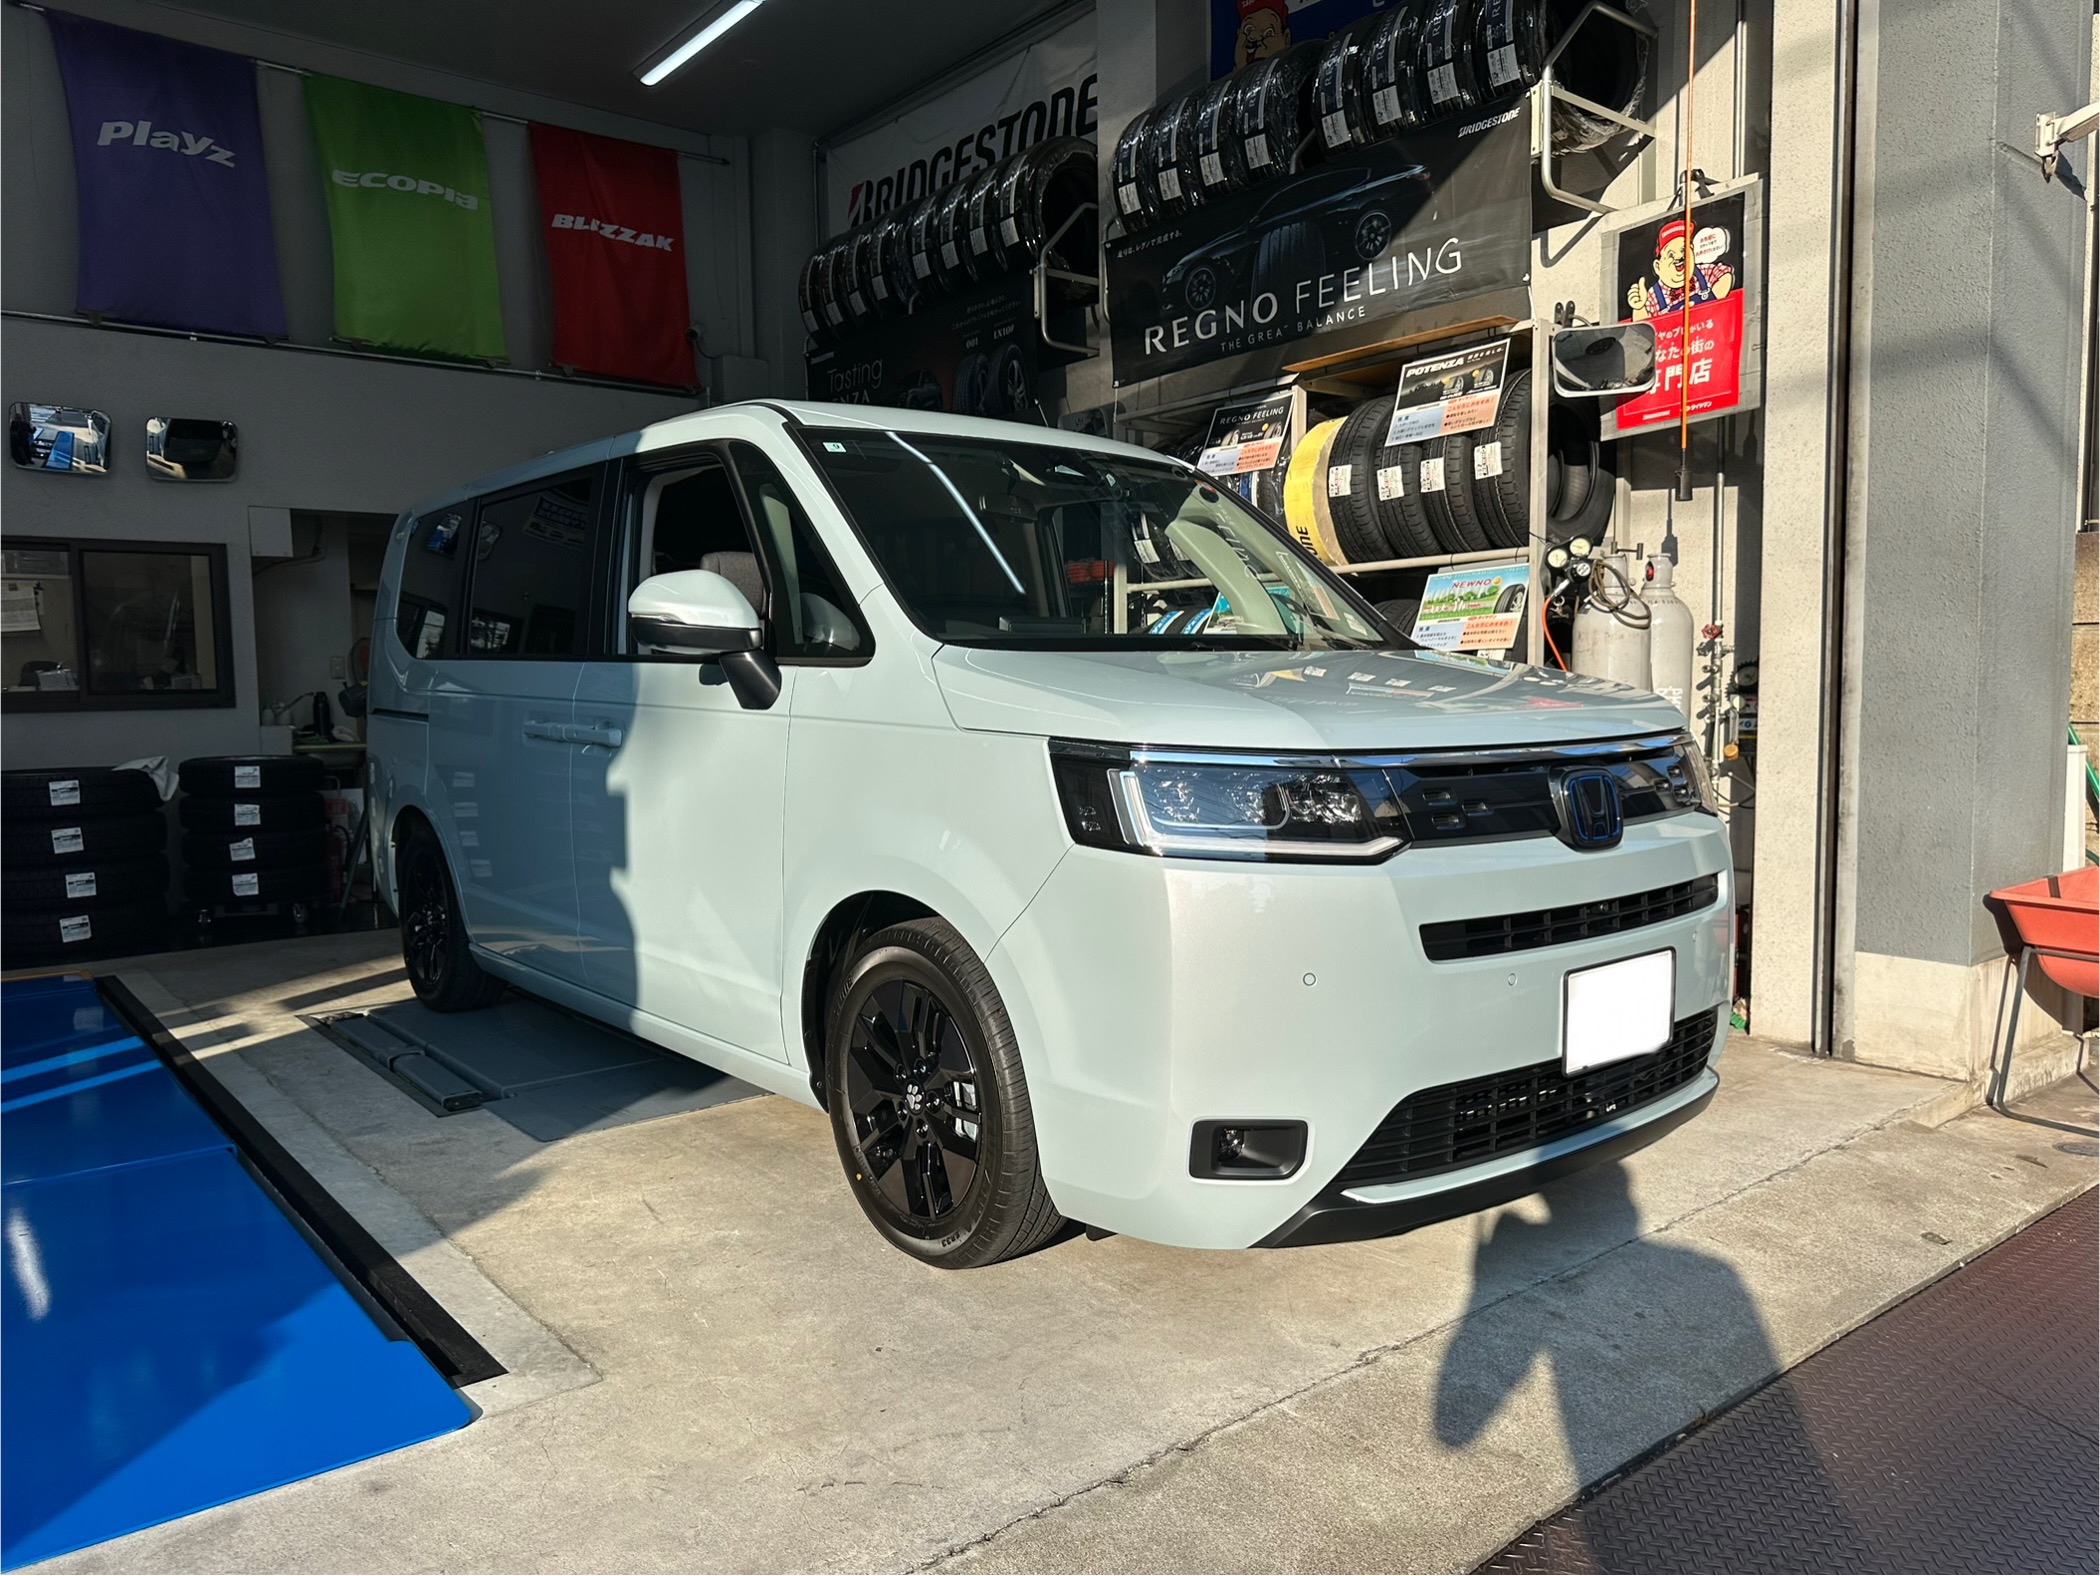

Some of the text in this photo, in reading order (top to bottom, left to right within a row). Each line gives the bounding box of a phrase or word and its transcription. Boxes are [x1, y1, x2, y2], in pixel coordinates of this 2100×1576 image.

[1458, 106, 1521, 138] BRIDGESTONE
[97, 120, 236, 168] Playz
[849, 73, 1097, 228] BRIDGESTONE
[551, 213, 674, 252] BLIZZAK
[1144, 236, 1463, 355] REGNO FEELING
[1220, 337, 1242, 352] THE
[1297, 305, 1366, 332] BALANCE
[826, 357, 884, 394] Tasting
[1405, 356, 1465, 378] POTENZA
[1219, 414, 1251, 425] REGNO
[1252, 406, 1285, 420] FEELING
[1451, 578, 1492, 590] NEWNO
